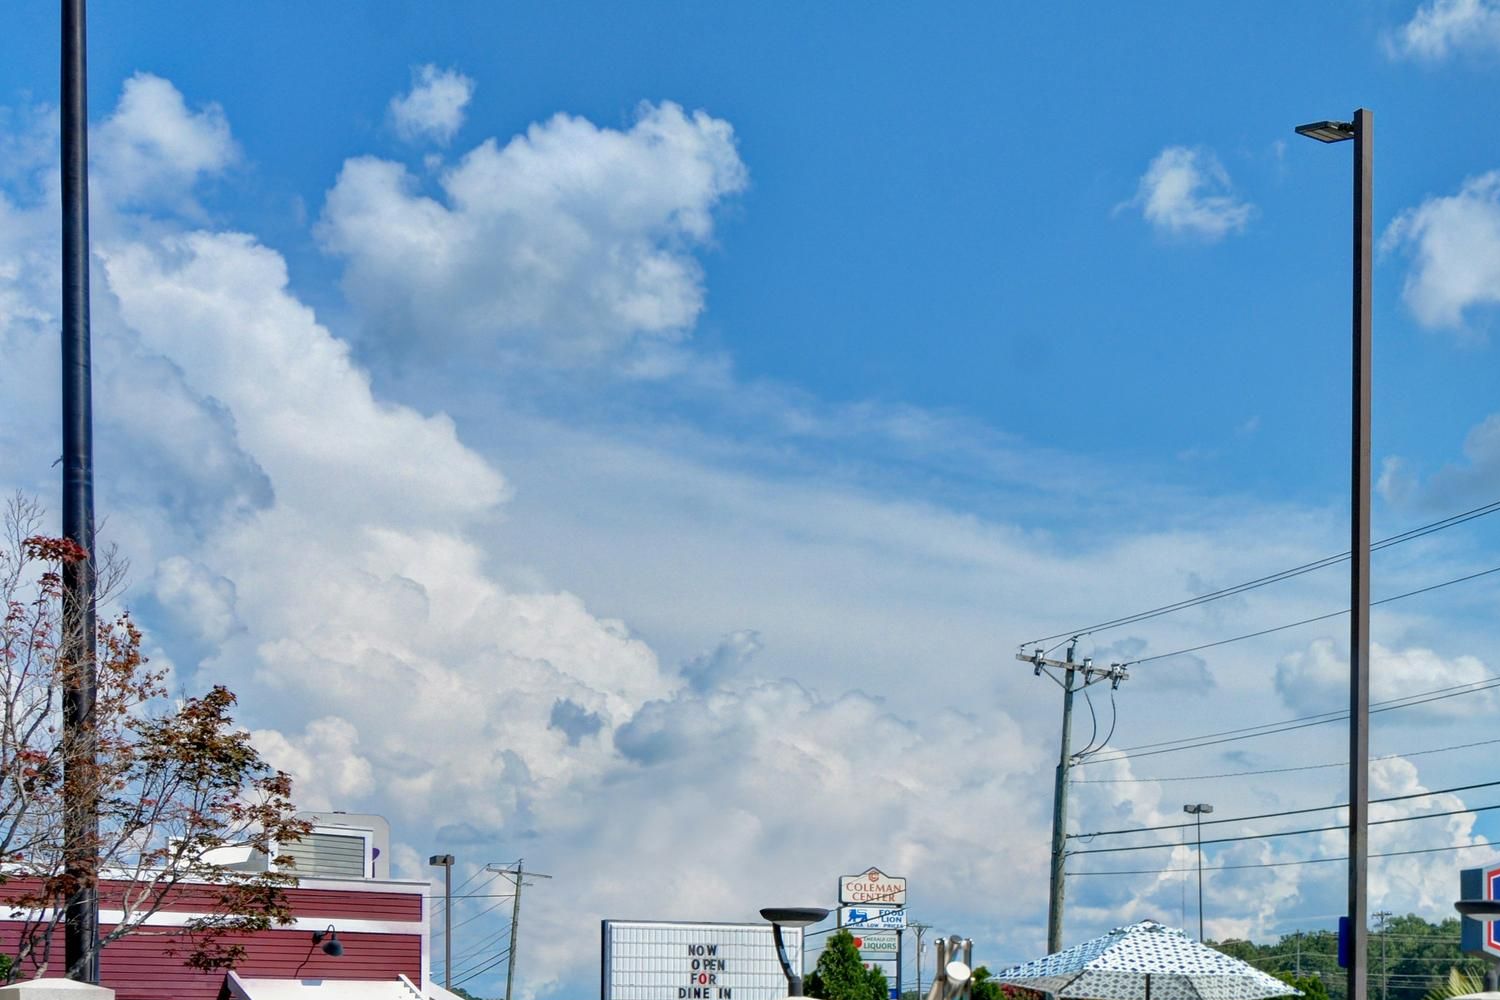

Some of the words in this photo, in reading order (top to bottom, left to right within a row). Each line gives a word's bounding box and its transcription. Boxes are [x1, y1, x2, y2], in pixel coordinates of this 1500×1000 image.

[846, 882, 901, 892] COLEMAN
[852, 892, 896, 902] CENTER
[688, 944, 718, 956] NOW
[863, 942, 897, 950] LIQUORS
[691, 959, 725, 971] OPEN
[690, 972, 717, 985] FOR
[678, 987, 710, 999] DINE
[719, 987, 732, 1000] IN
